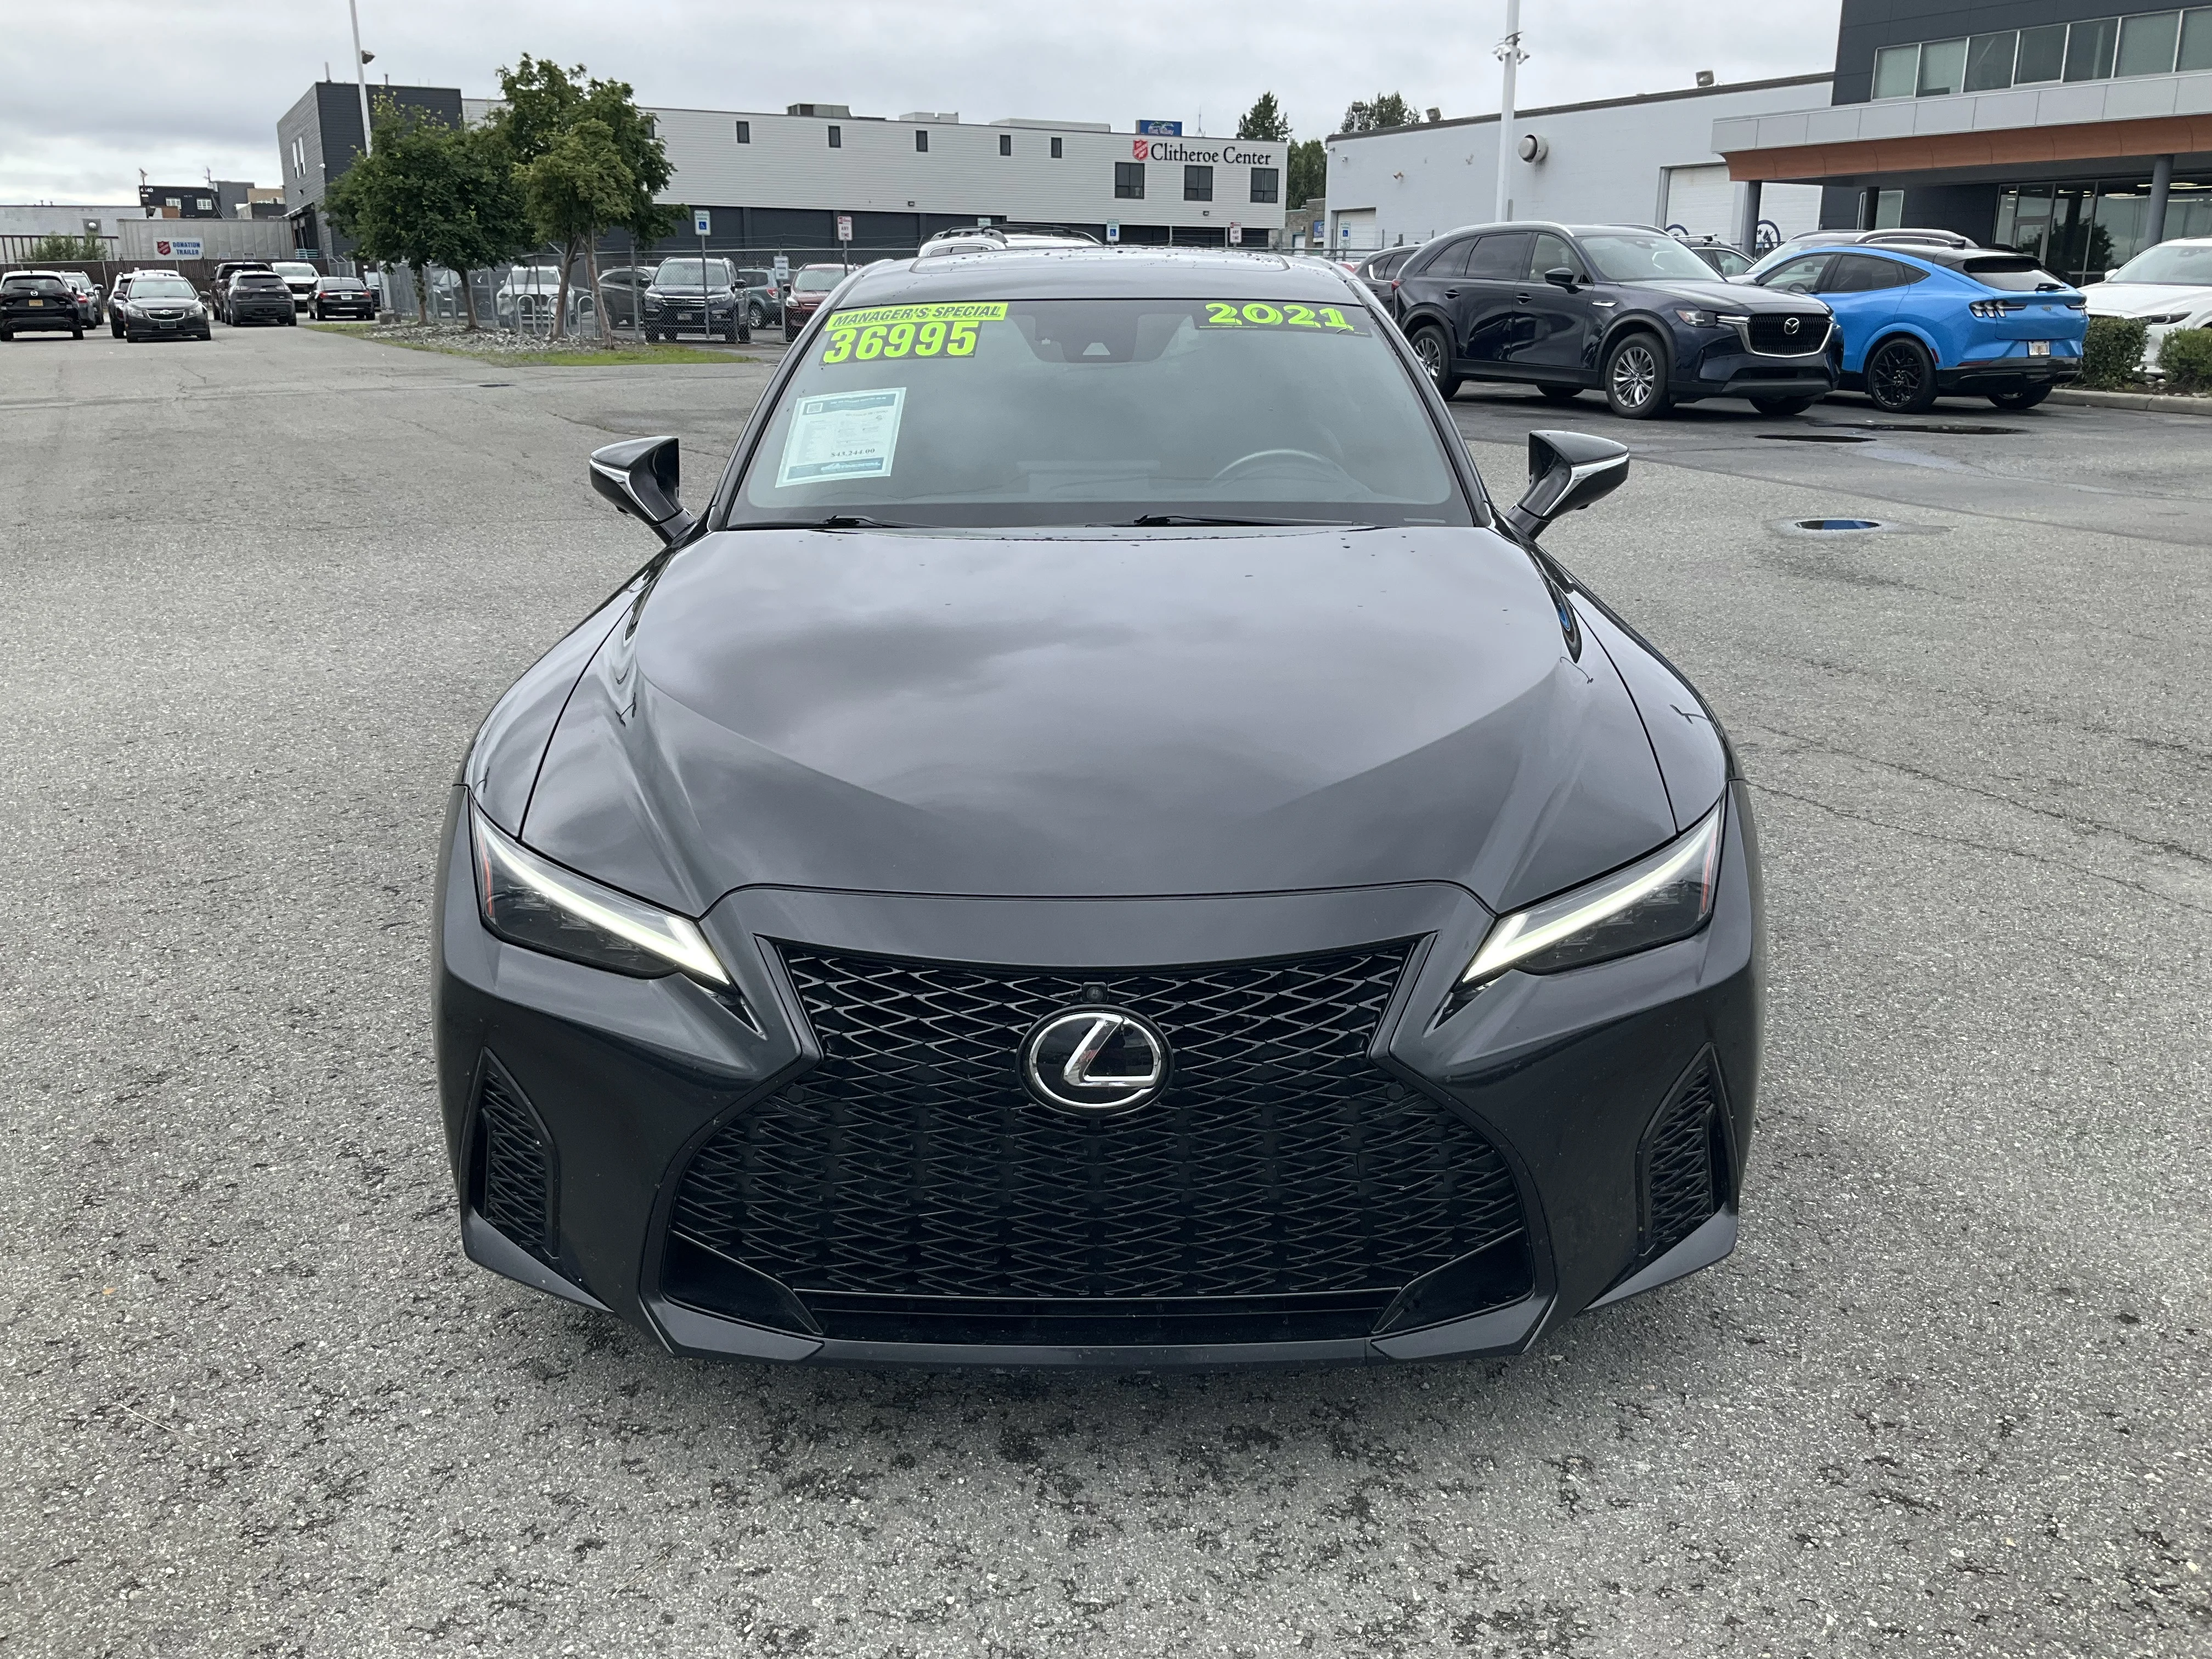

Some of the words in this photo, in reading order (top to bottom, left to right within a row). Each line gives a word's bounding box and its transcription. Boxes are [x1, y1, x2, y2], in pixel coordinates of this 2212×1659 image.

[1150, 143, 1219, 162] Clitheroe
[1223, 146, 1271, 165] Center
[832, 307, 932, 328] MANAGER'S
[932, 306, 1001, 318] SPECIAL
[1205, 302, 1355, 331] 2021
[823, 321, 980, 364] 36995
